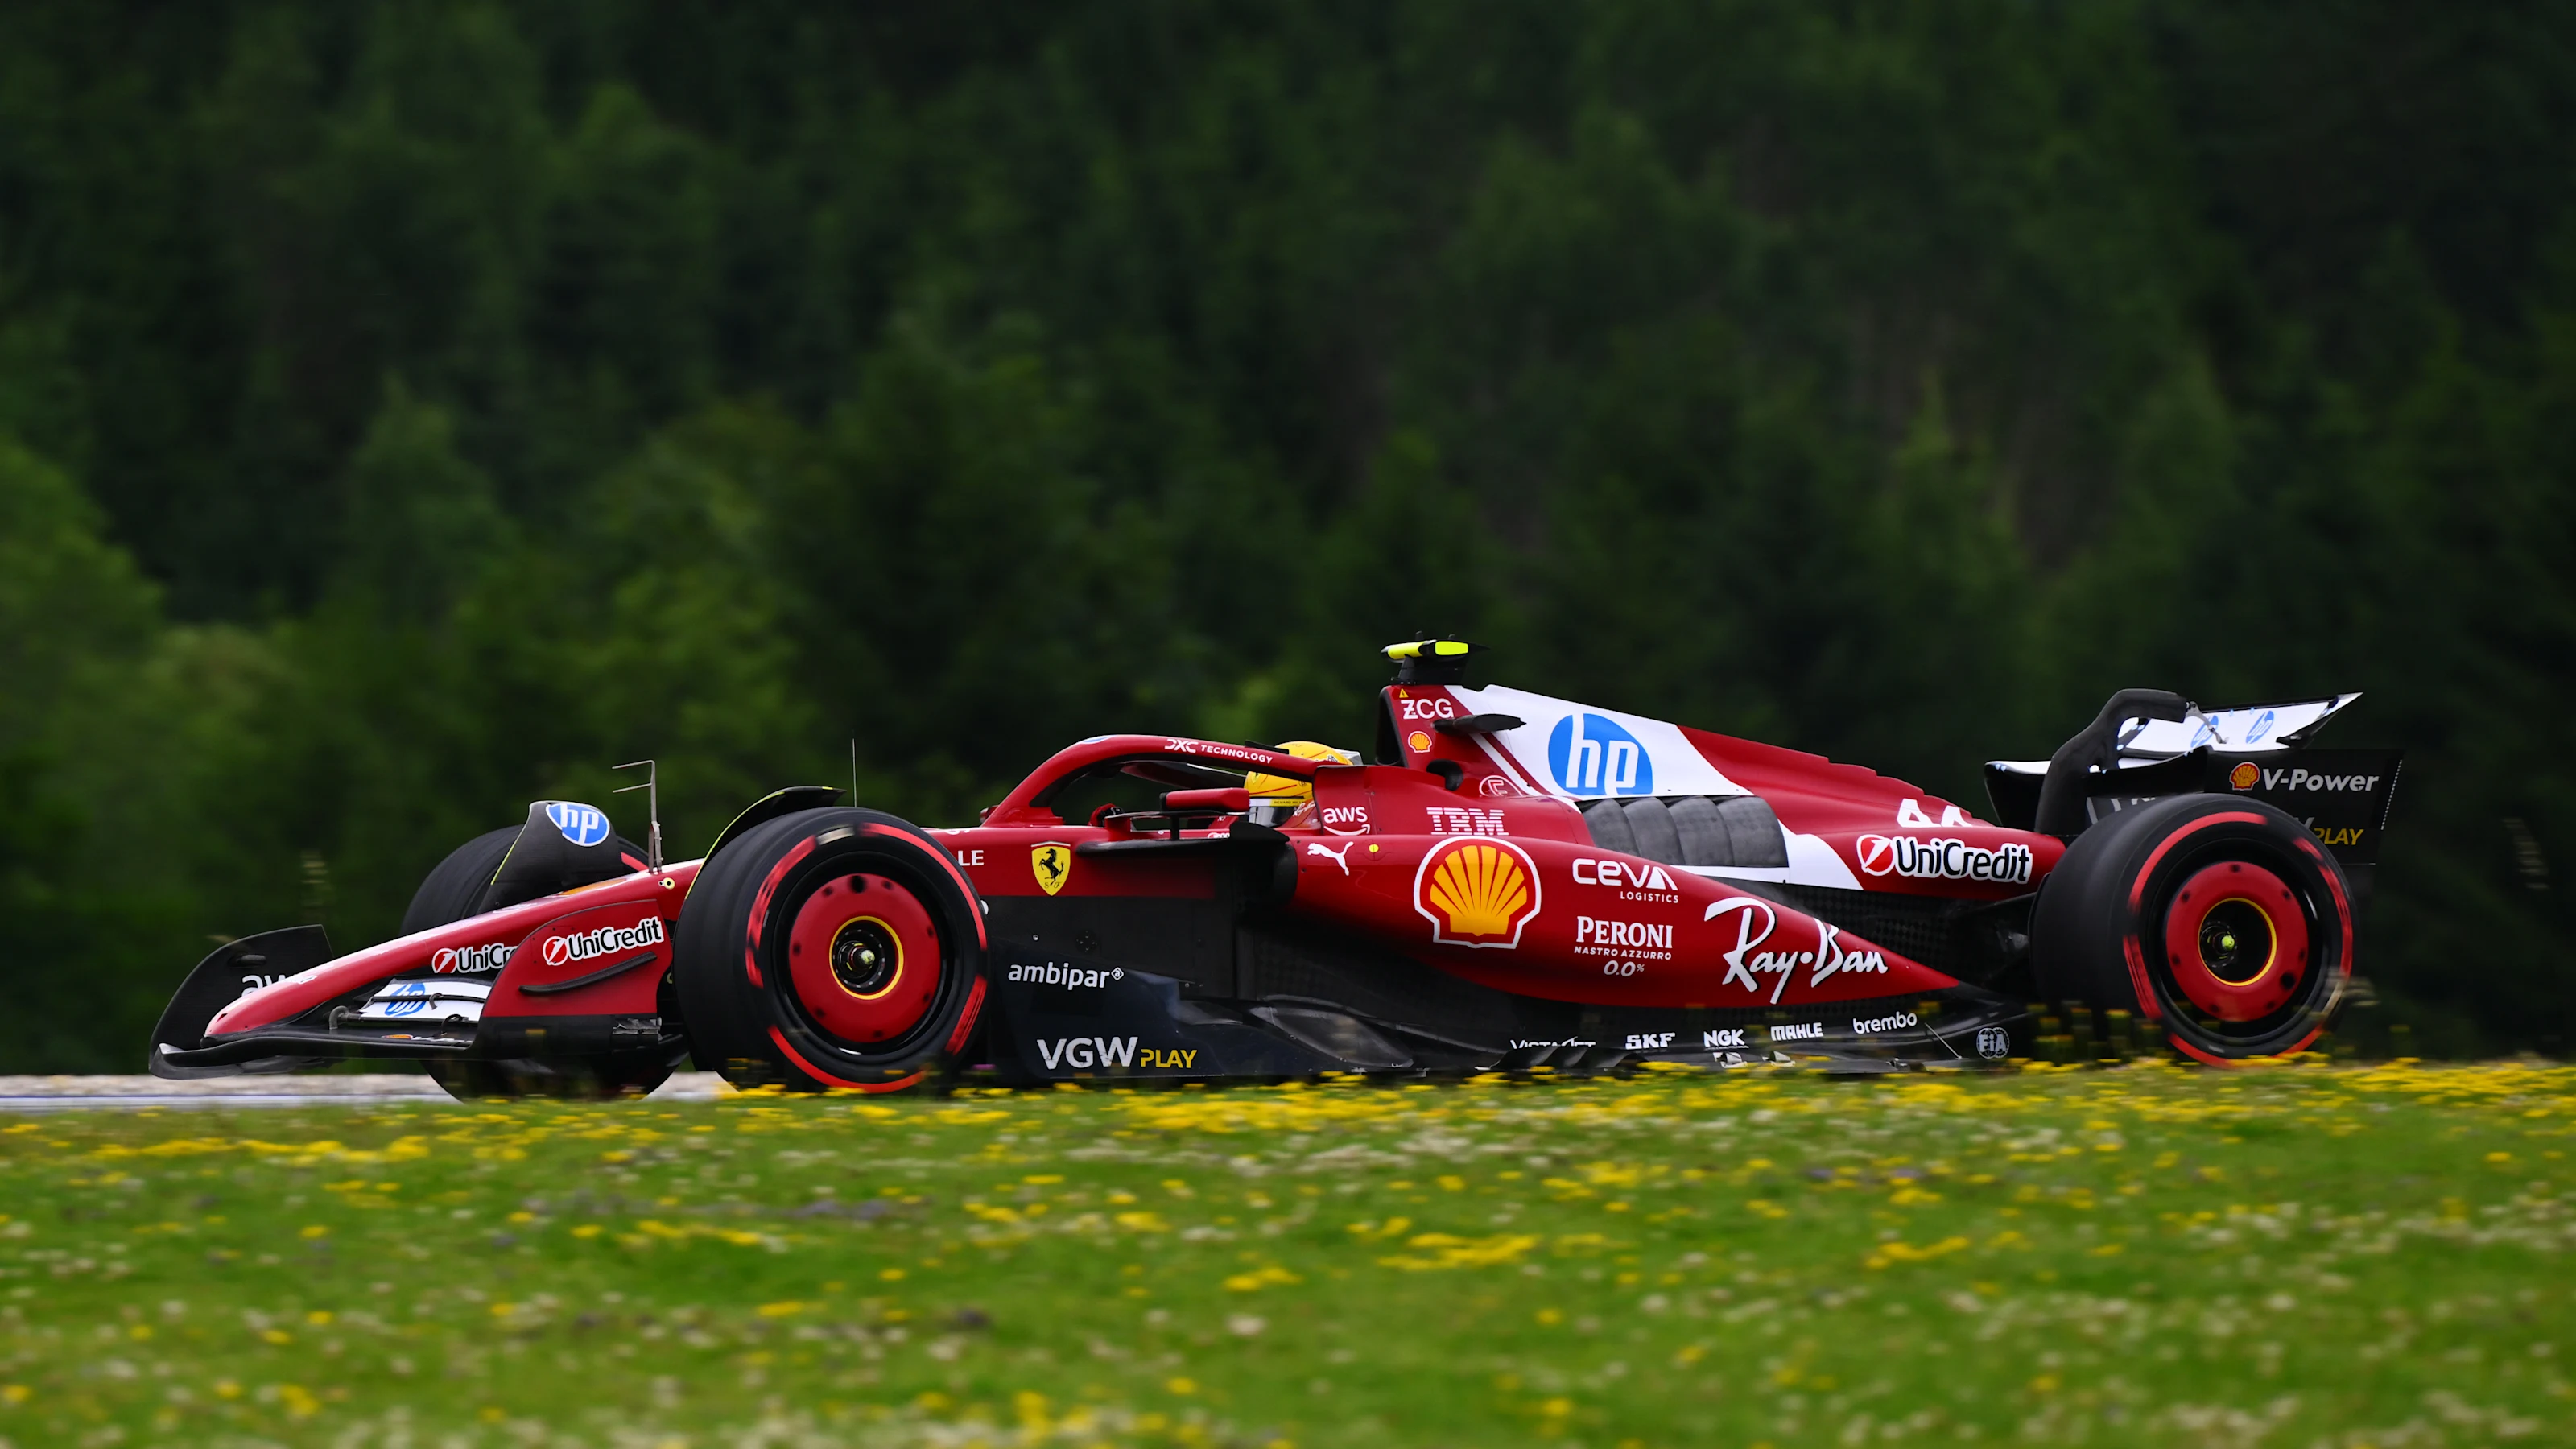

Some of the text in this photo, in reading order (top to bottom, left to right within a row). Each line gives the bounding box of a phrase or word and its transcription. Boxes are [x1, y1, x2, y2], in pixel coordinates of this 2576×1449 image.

[1165, 738, 1274, 764] DXC TECHNOLOGY
[1565, 712, 1640, 795] hp
[2262, 768, 2380, 791] V-Power
[559, 803, 599, 845] hp
[1323, 806, 1368, 824] aws
[1426, 807, 1509, 836] IBM
[1895, 838, 2030, 881] UniCredit
[1620, 891, 1679, 903] LOGISTICS
[568, 917, 663, 959] UniCredit
[1576, 915, 1674, 949] PERONI
[1574, 946, 1672, 960] NASTRO AZZURRO
[1008, 961, 1110, 990] ambipar
[1603, 960, 1645, 977] 0.0%
[1770, 1022, 1824, 1042] MAHLE
[1852, 1011, 1918, 1035] brembo
[1625, 1032, 1676, 1050] SKF
[1703, 1028, 1745, 1047] NGK
[1036, 1036, 1198, 1070] VGW PLAY
